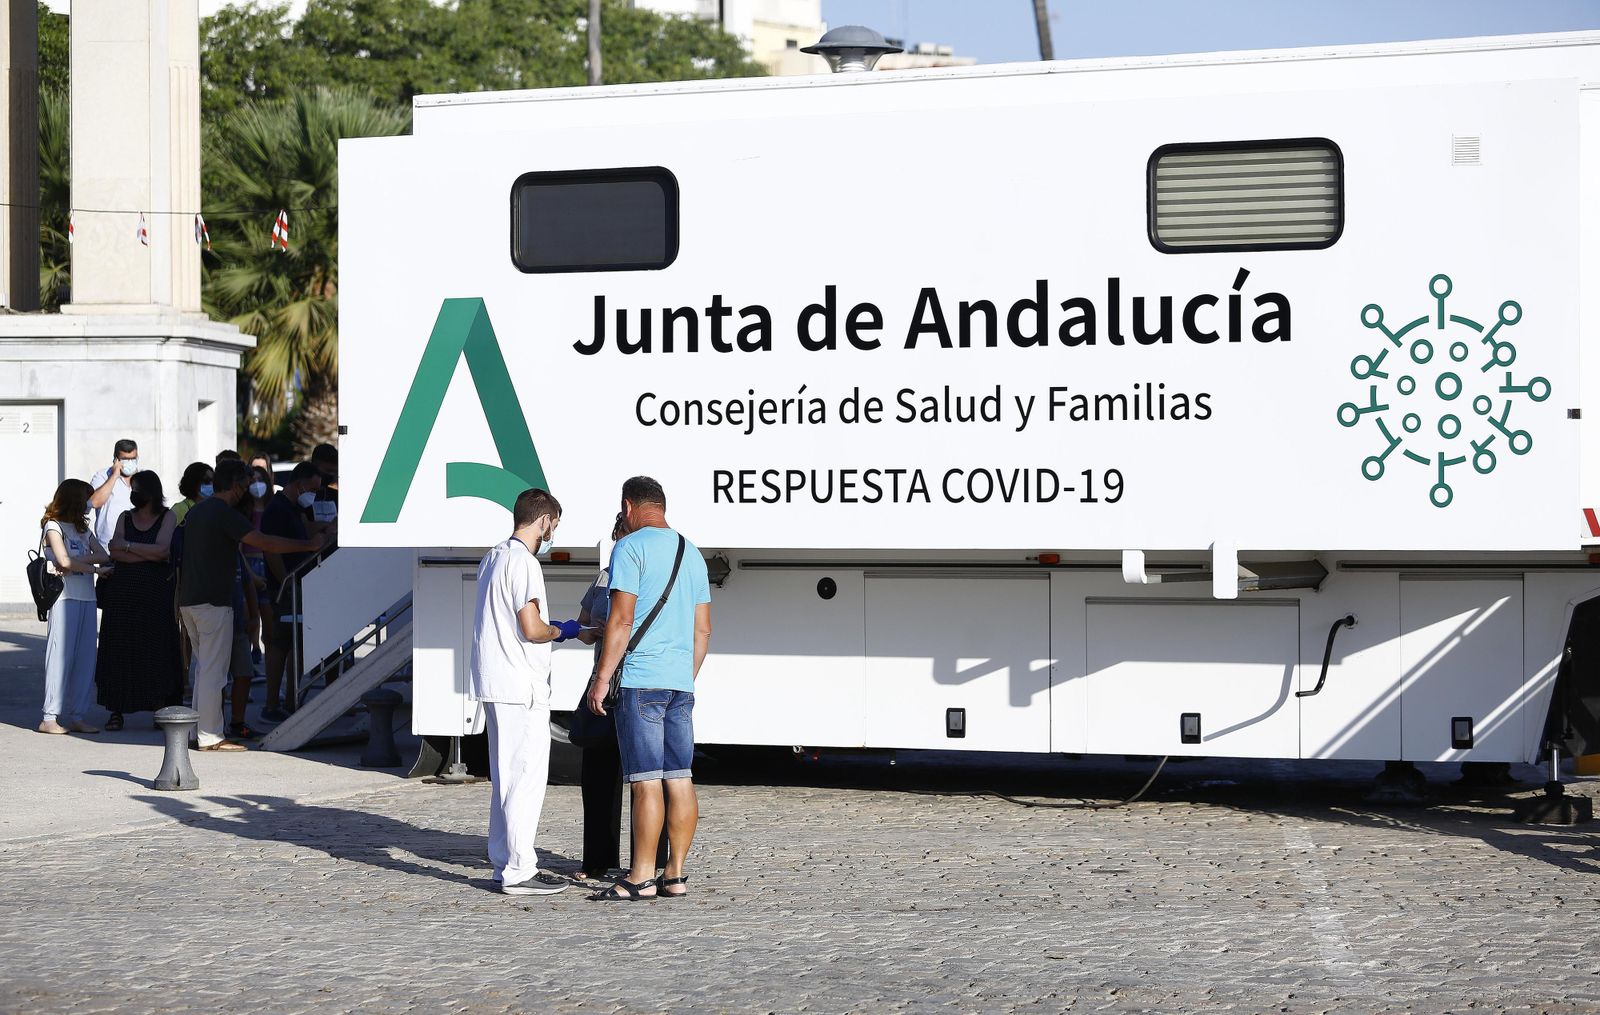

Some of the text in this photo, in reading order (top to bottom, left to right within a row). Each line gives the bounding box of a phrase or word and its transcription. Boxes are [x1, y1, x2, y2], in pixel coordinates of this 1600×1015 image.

[573, 267, 1291, 355] Junta de Andalucía
[22, 422, 30, 434] 2
[636, 382, 1212, 435] Consejería de Salud y Familias
[714, 468, 1124, 504] RESPUESTA COVID-19
